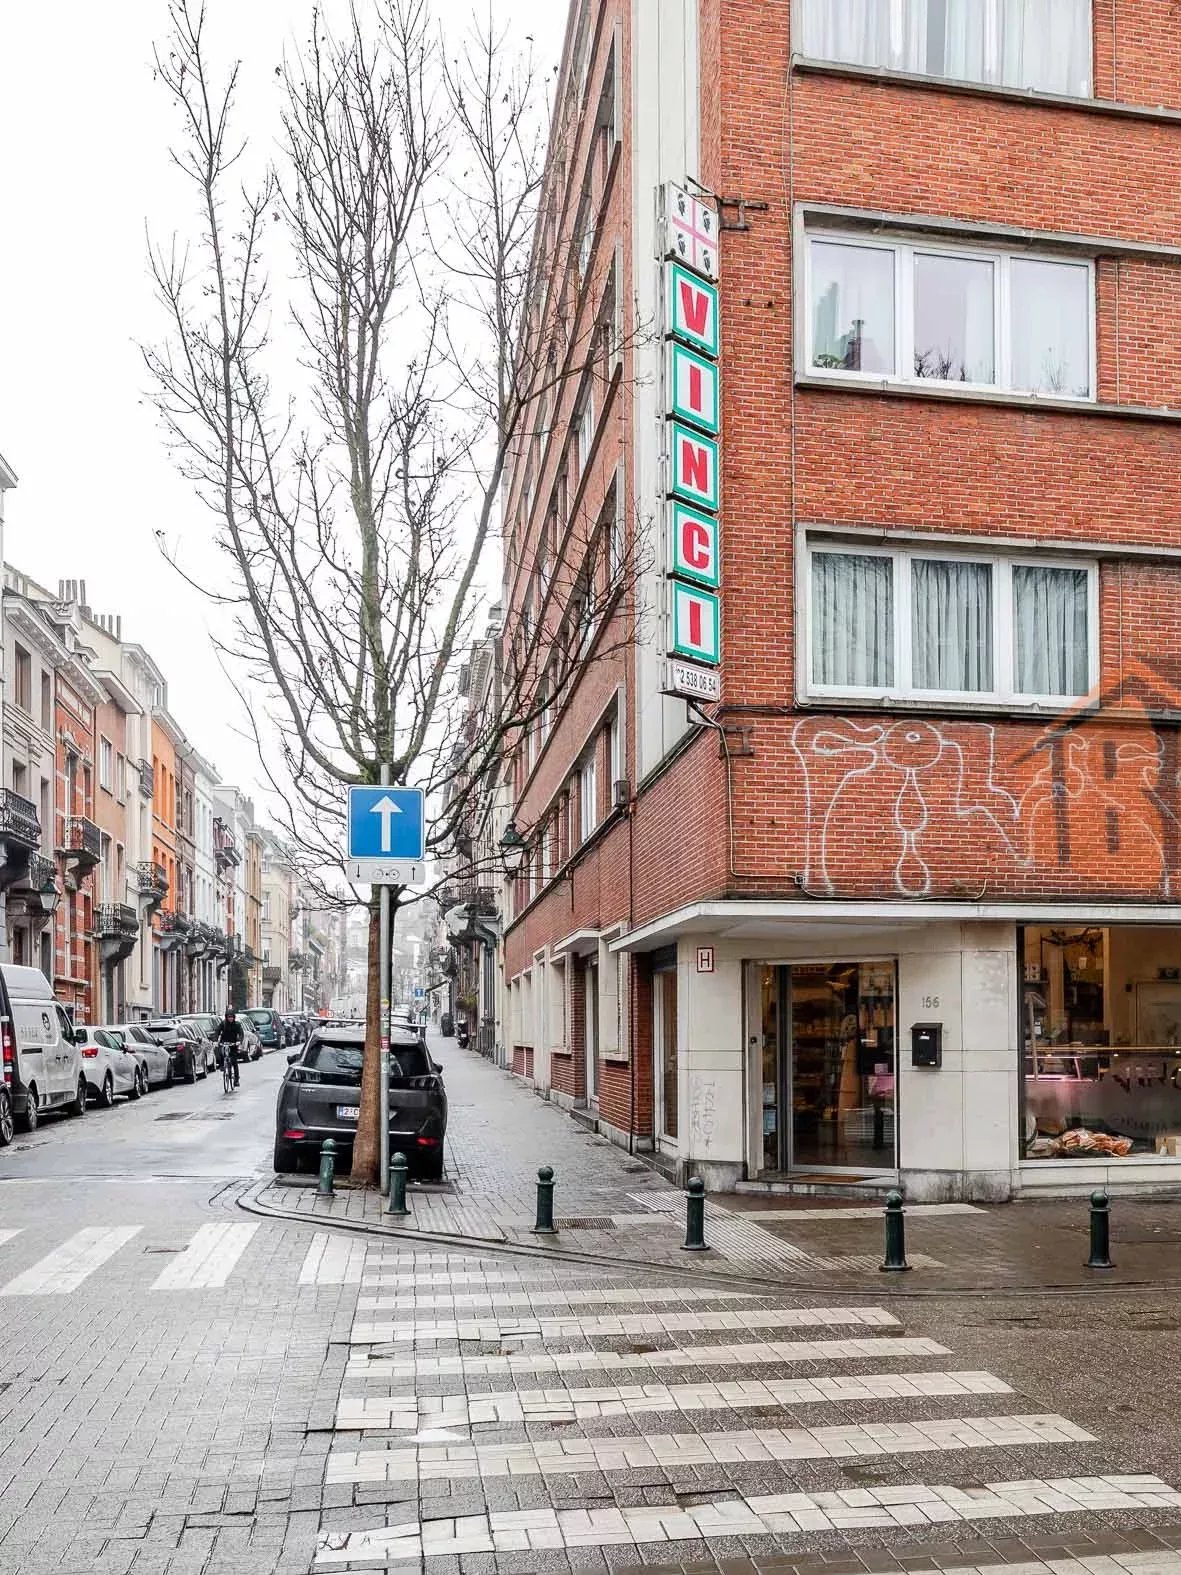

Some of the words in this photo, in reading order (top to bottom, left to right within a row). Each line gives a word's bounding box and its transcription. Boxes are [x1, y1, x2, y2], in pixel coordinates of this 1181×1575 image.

[680, 280, 710, 646] VINCI
[686, 671, 698, 688] 538
[700, 951, 710, 969] H
[922, 996, 941, 1009] 156
